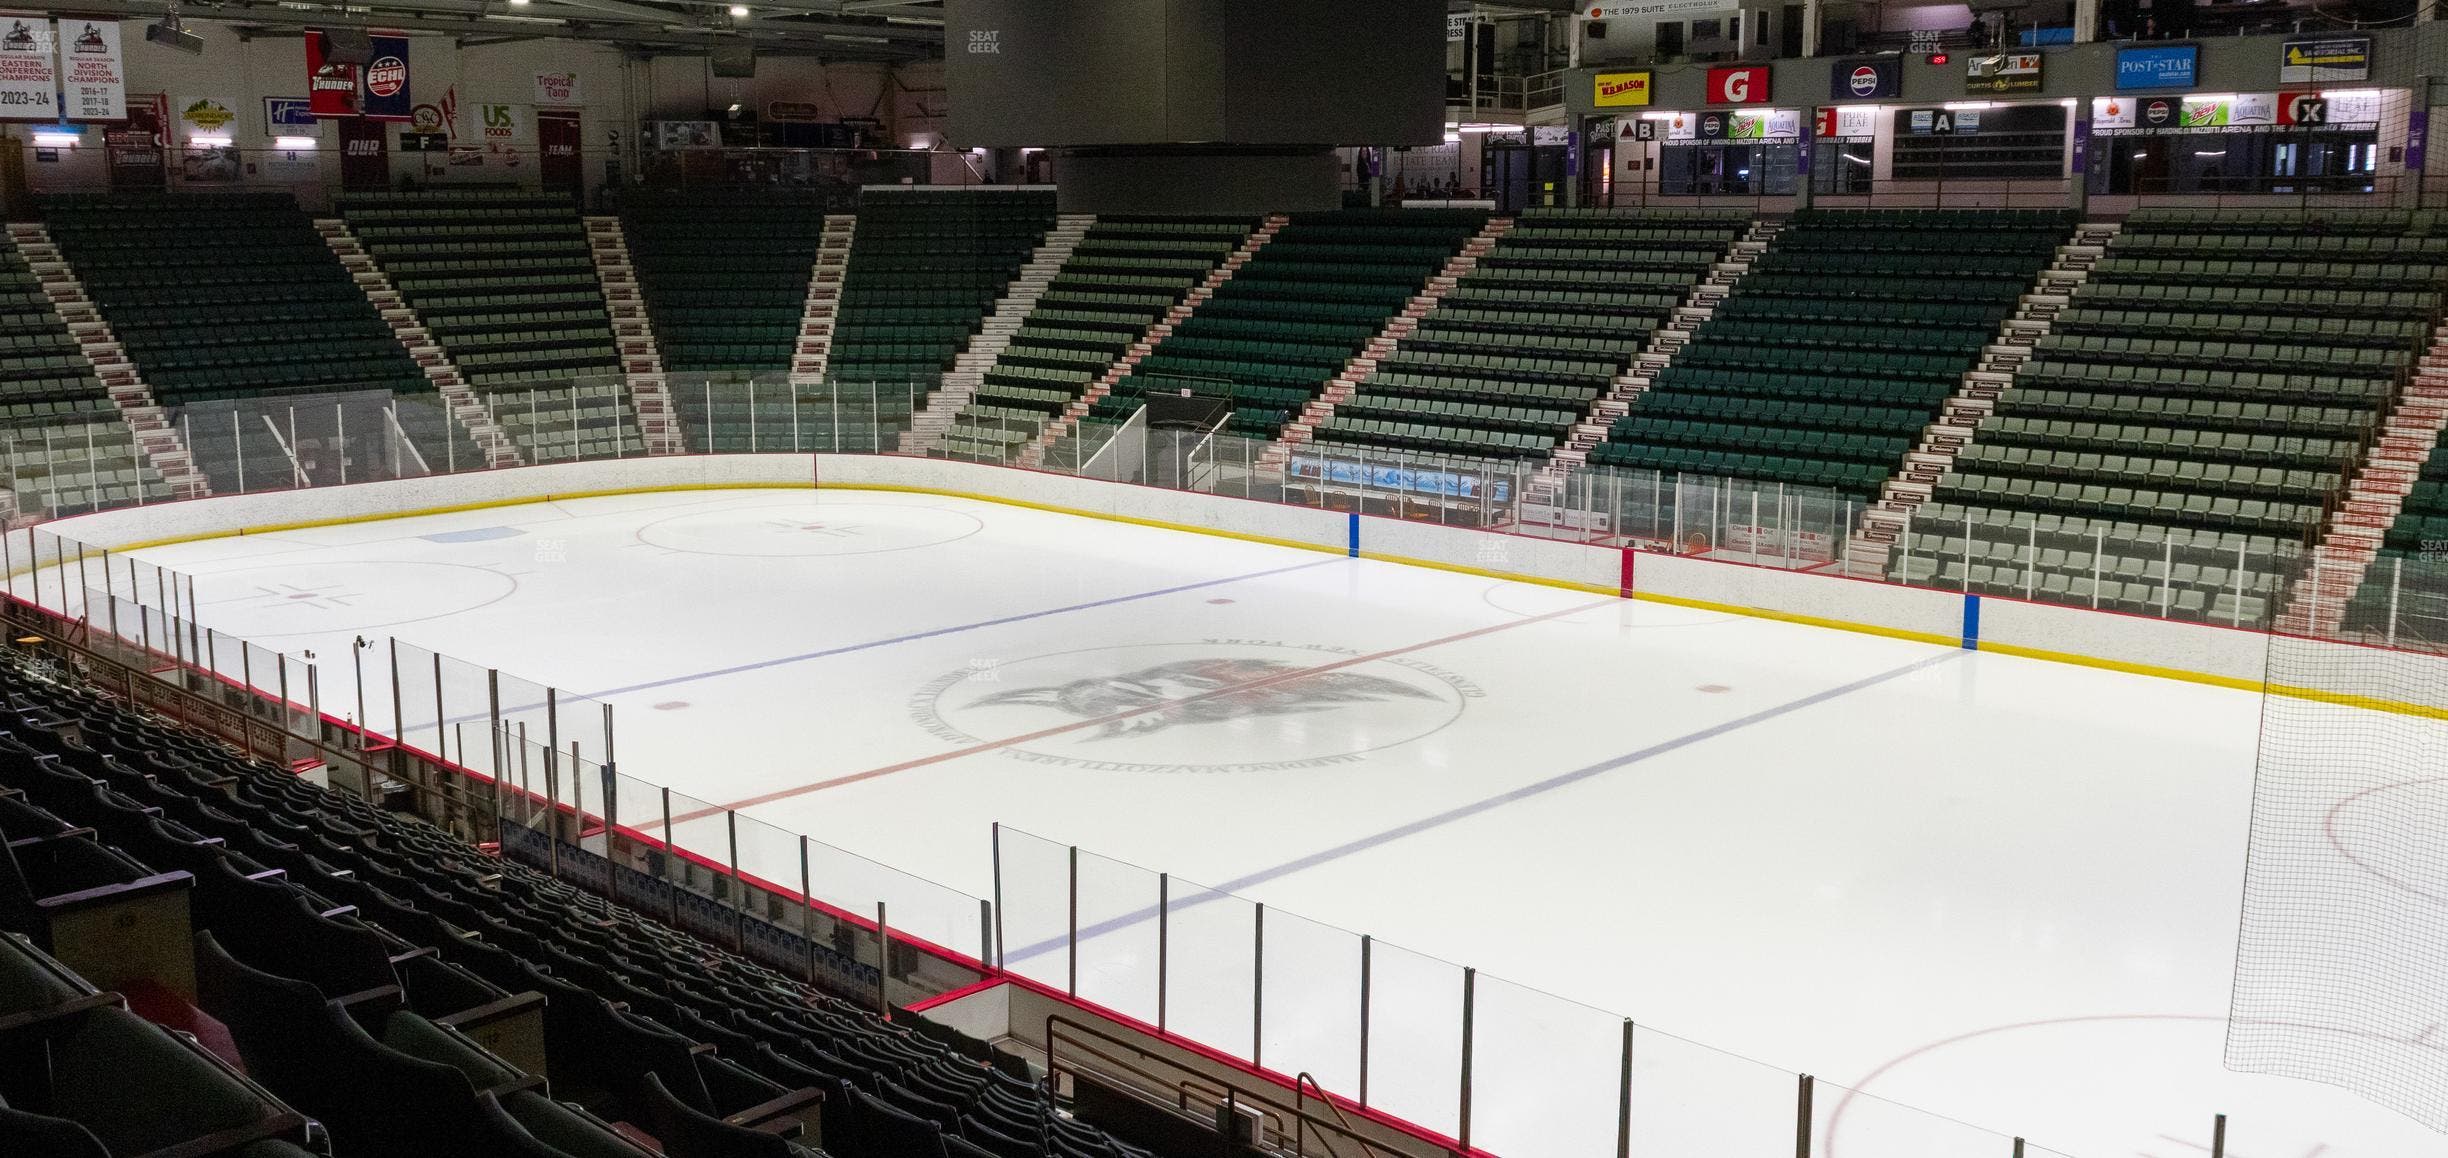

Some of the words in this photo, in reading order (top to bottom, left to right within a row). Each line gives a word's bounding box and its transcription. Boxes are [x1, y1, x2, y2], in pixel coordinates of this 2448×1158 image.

[1603, 8, 1619, 16] THE
[1622, 7, 1640, 15] 1979
[1642, 5, 1665, 14] SUITE
[2121, 60, 2152, 73] POST
[2159, 58, 2191, 71] STAR
[67, 76, 120, 84] CHAMPIONS
[370, 69, 404, 84] ECHL
[537, 75, 574, 88] Tropical
[1851, 77, 1877, 87] PEPSI
[312, 77, 354, 91] THUNDER
[81, 87, 108, 95] 2016-17
[1, 91, 50, 105] 2023-24
[83, 108, 110, 116] 2023-24
[1843, 119, 1869, 128] LEAF
[1935, 114, 1950, 131] A
[485, 128, 513, 137] FOODS
[1640, 123, 1651, 138] B
[2114, 128, 2145, 136] SPONSOR
[347, 140, 380, 156] OUR
[420, 137, 430, 149] F
